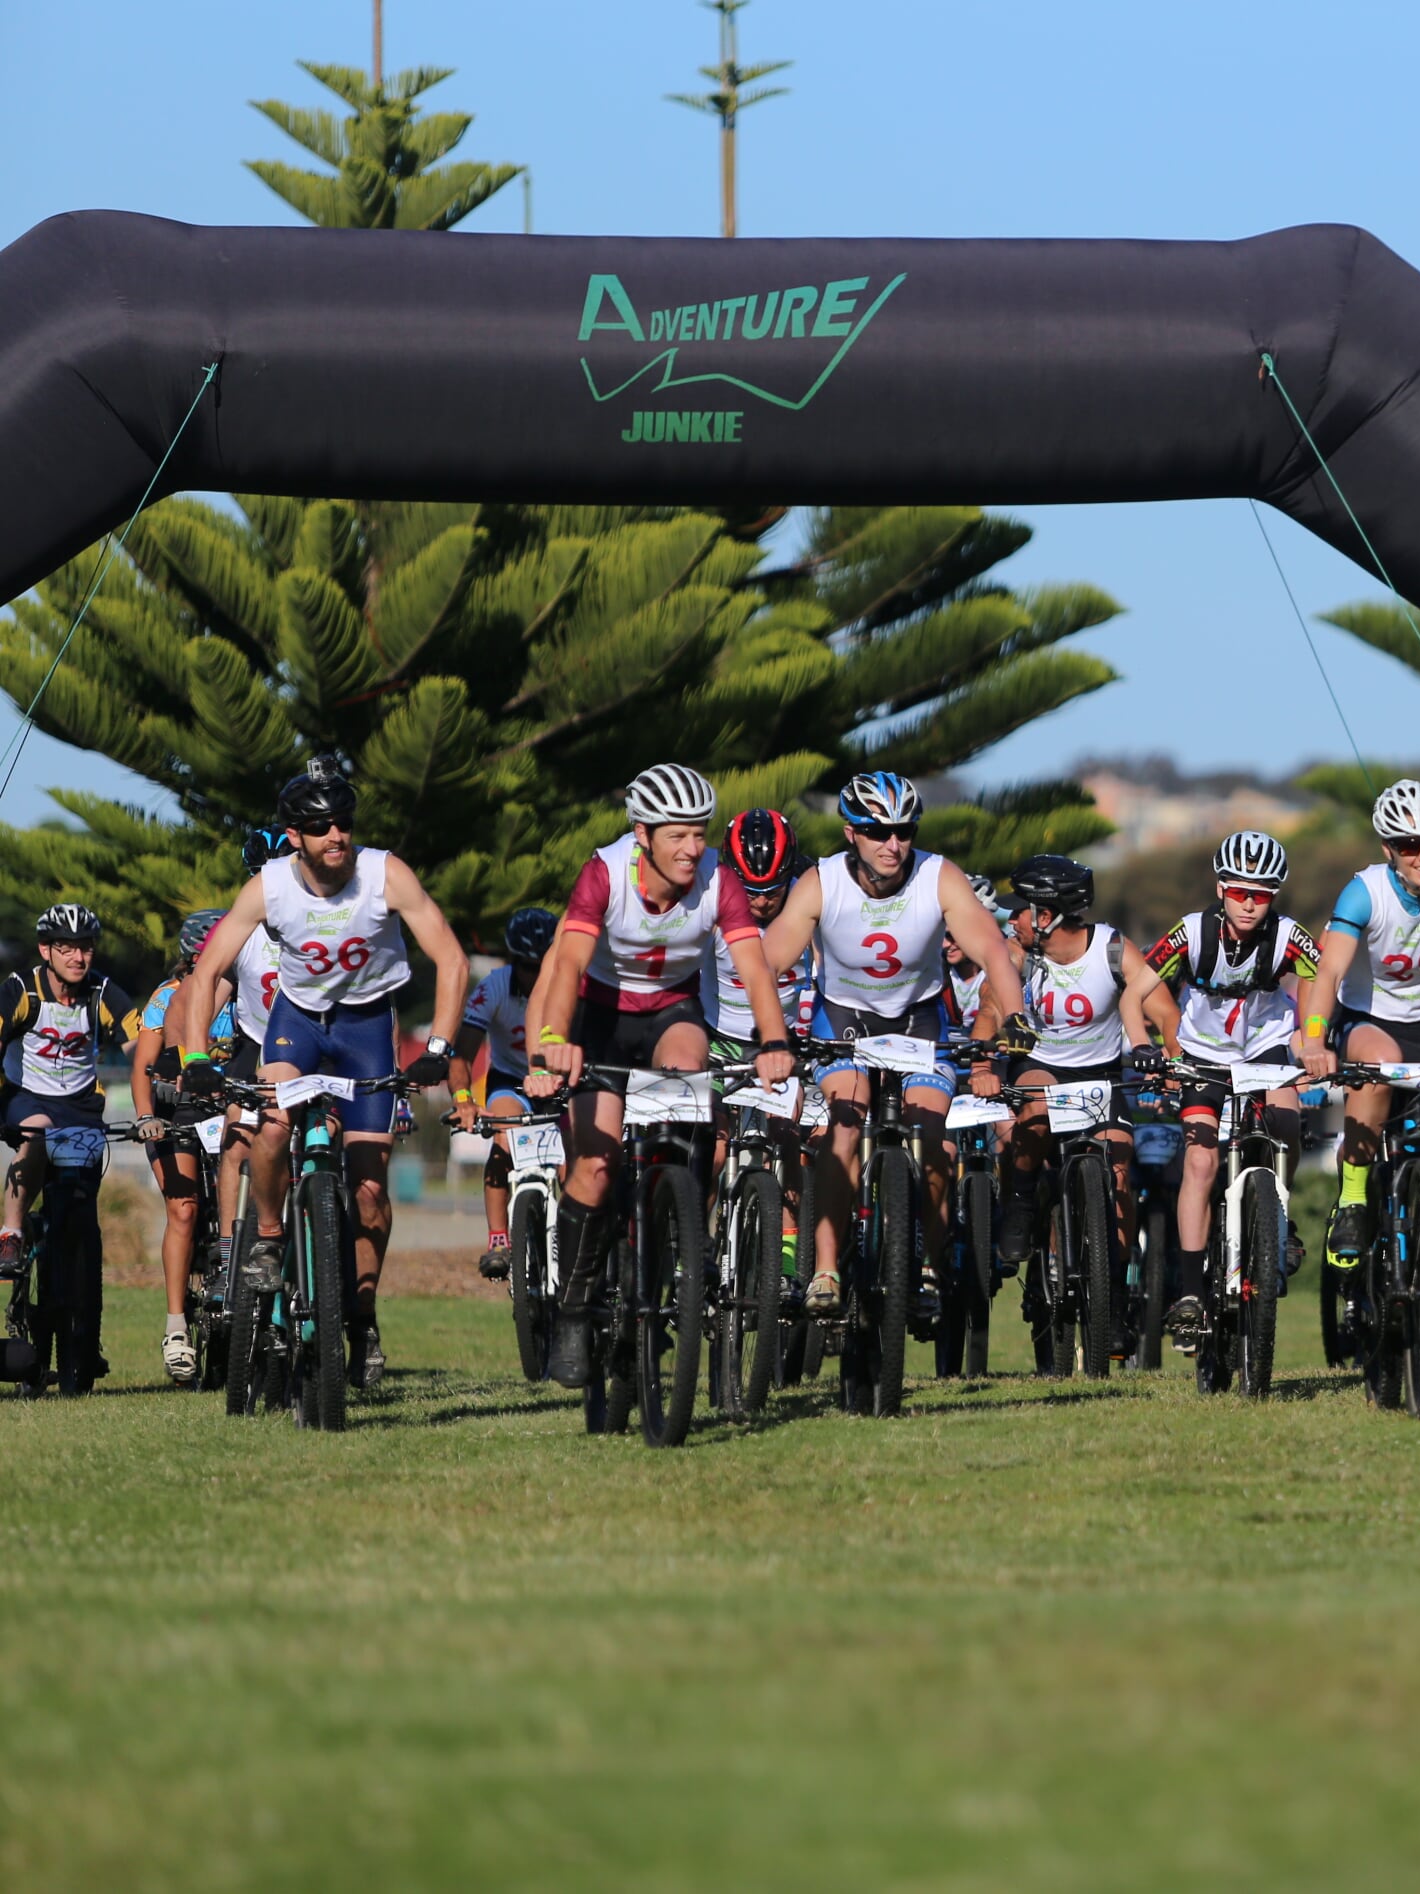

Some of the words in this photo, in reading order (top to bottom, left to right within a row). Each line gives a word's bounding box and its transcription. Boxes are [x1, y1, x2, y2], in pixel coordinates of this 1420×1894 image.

[577, 274, 870, 342] ADVENTURE
[621, 411, 744, 442] JUNKIE
[300, 936, 370, 976] 36
[635, 945, 667, 978] 1
[861, 932, 903, 979] 3
[1038, 991, 1094, 1027] 19
[904, 1040, 918, 1054] 3
[313, 1077, 345, 1094] 36
[1076, 1086, 1104, 1109] 19
